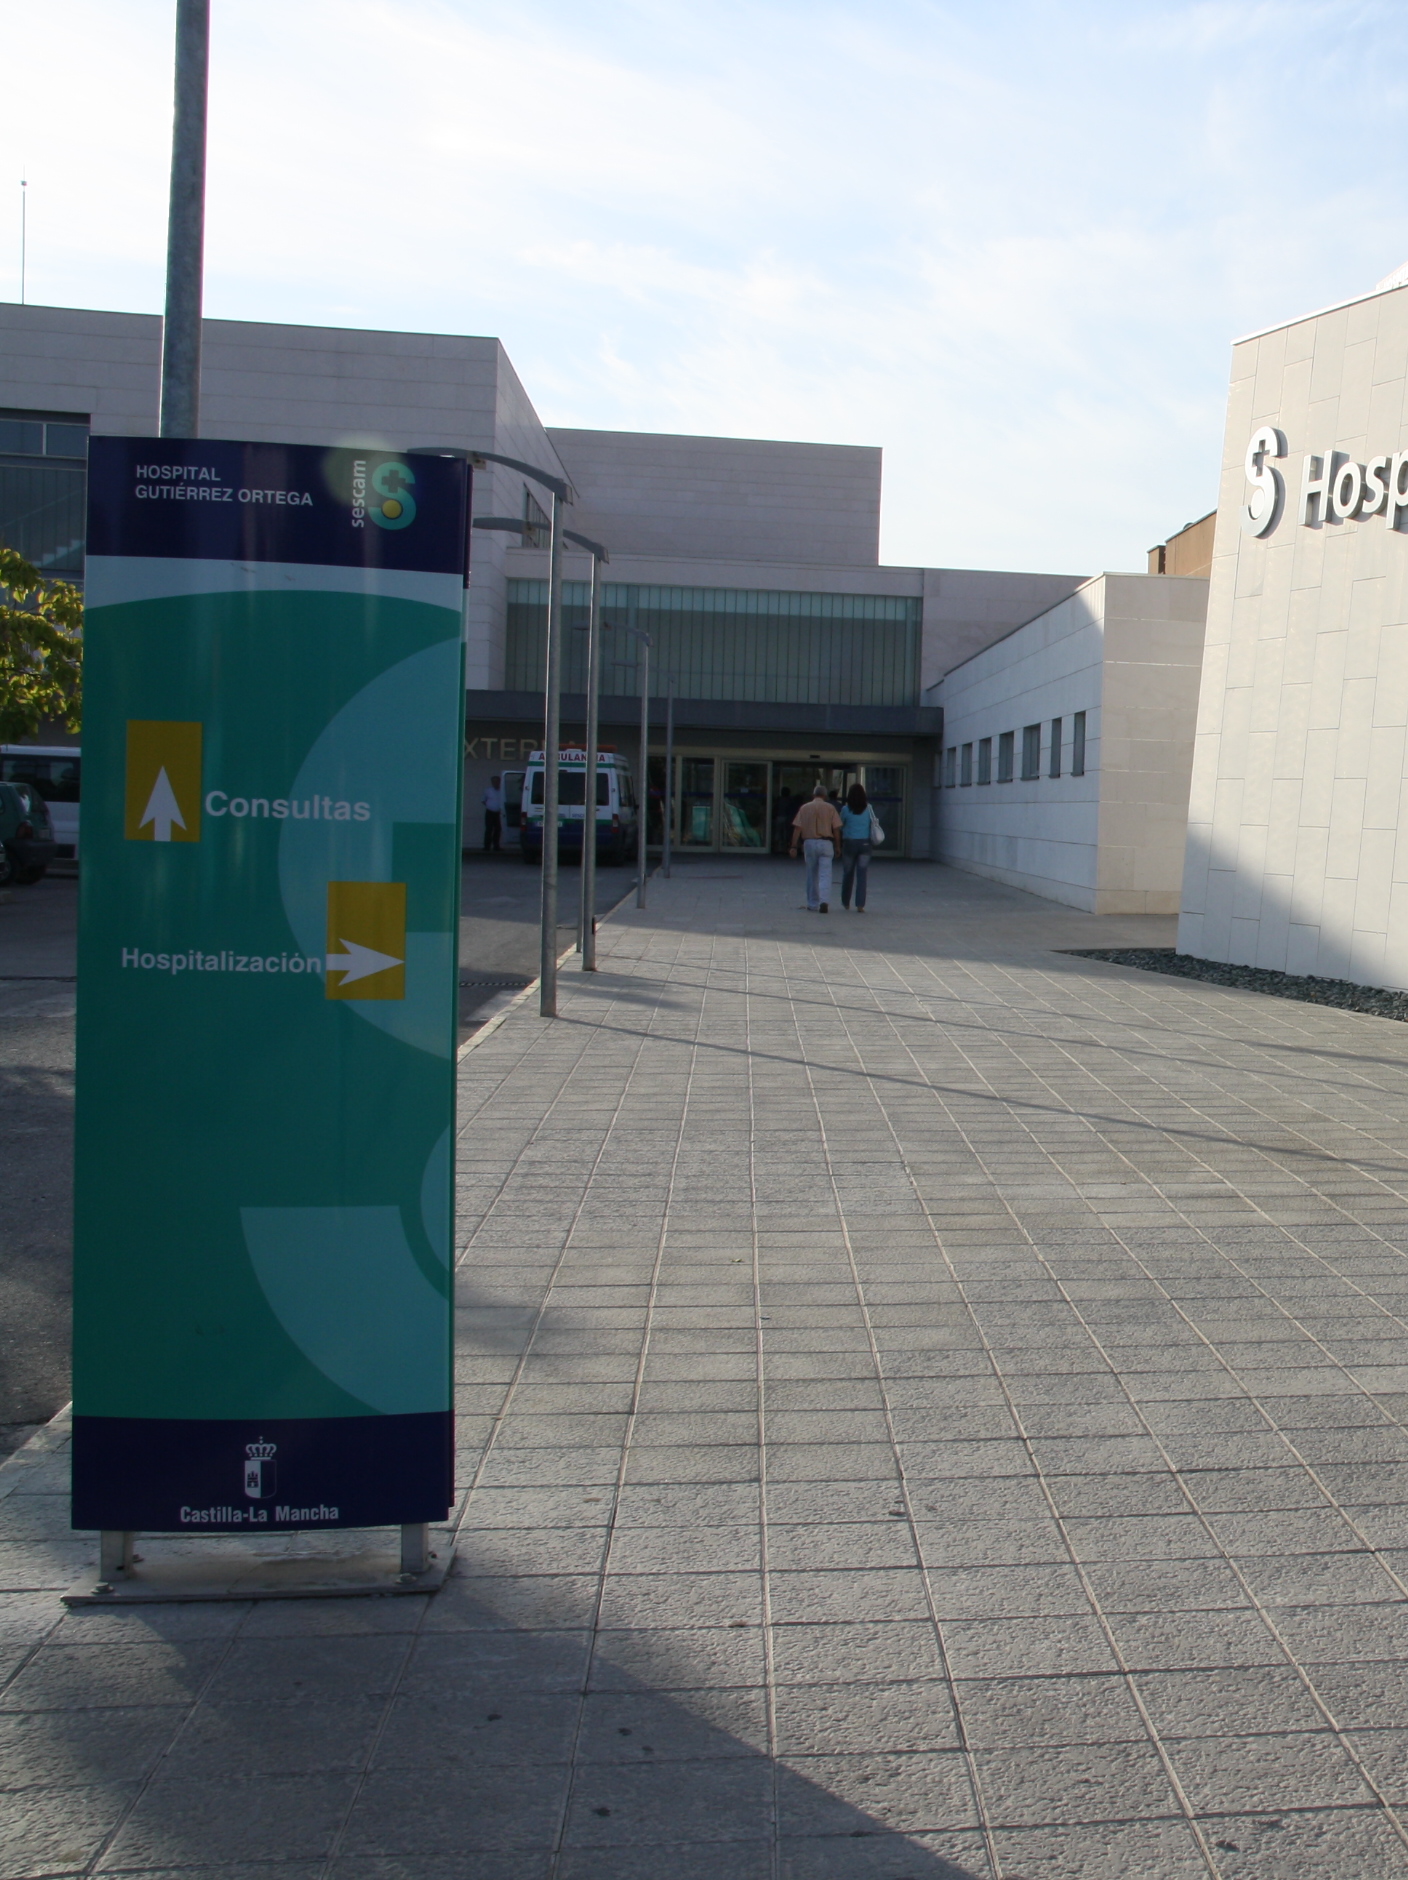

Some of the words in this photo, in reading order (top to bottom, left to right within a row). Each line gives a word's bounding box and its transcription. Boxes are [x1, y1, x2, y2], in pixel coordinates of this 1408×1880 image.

[135, 464, 222, 482] HOSPITAL
[135, 482, 234, 502] GUTIÉRREZ
[237, 488, 314, 506] ORTEGA
[351, 459, 367, 528] sescam
[204, 790, 371, 822] Consultas
[121, 947, 322, 975] Hospitalización
[179, 1505, 268, 1523] Castilla-La
[275, 1504, 339, 1522] Mancha
